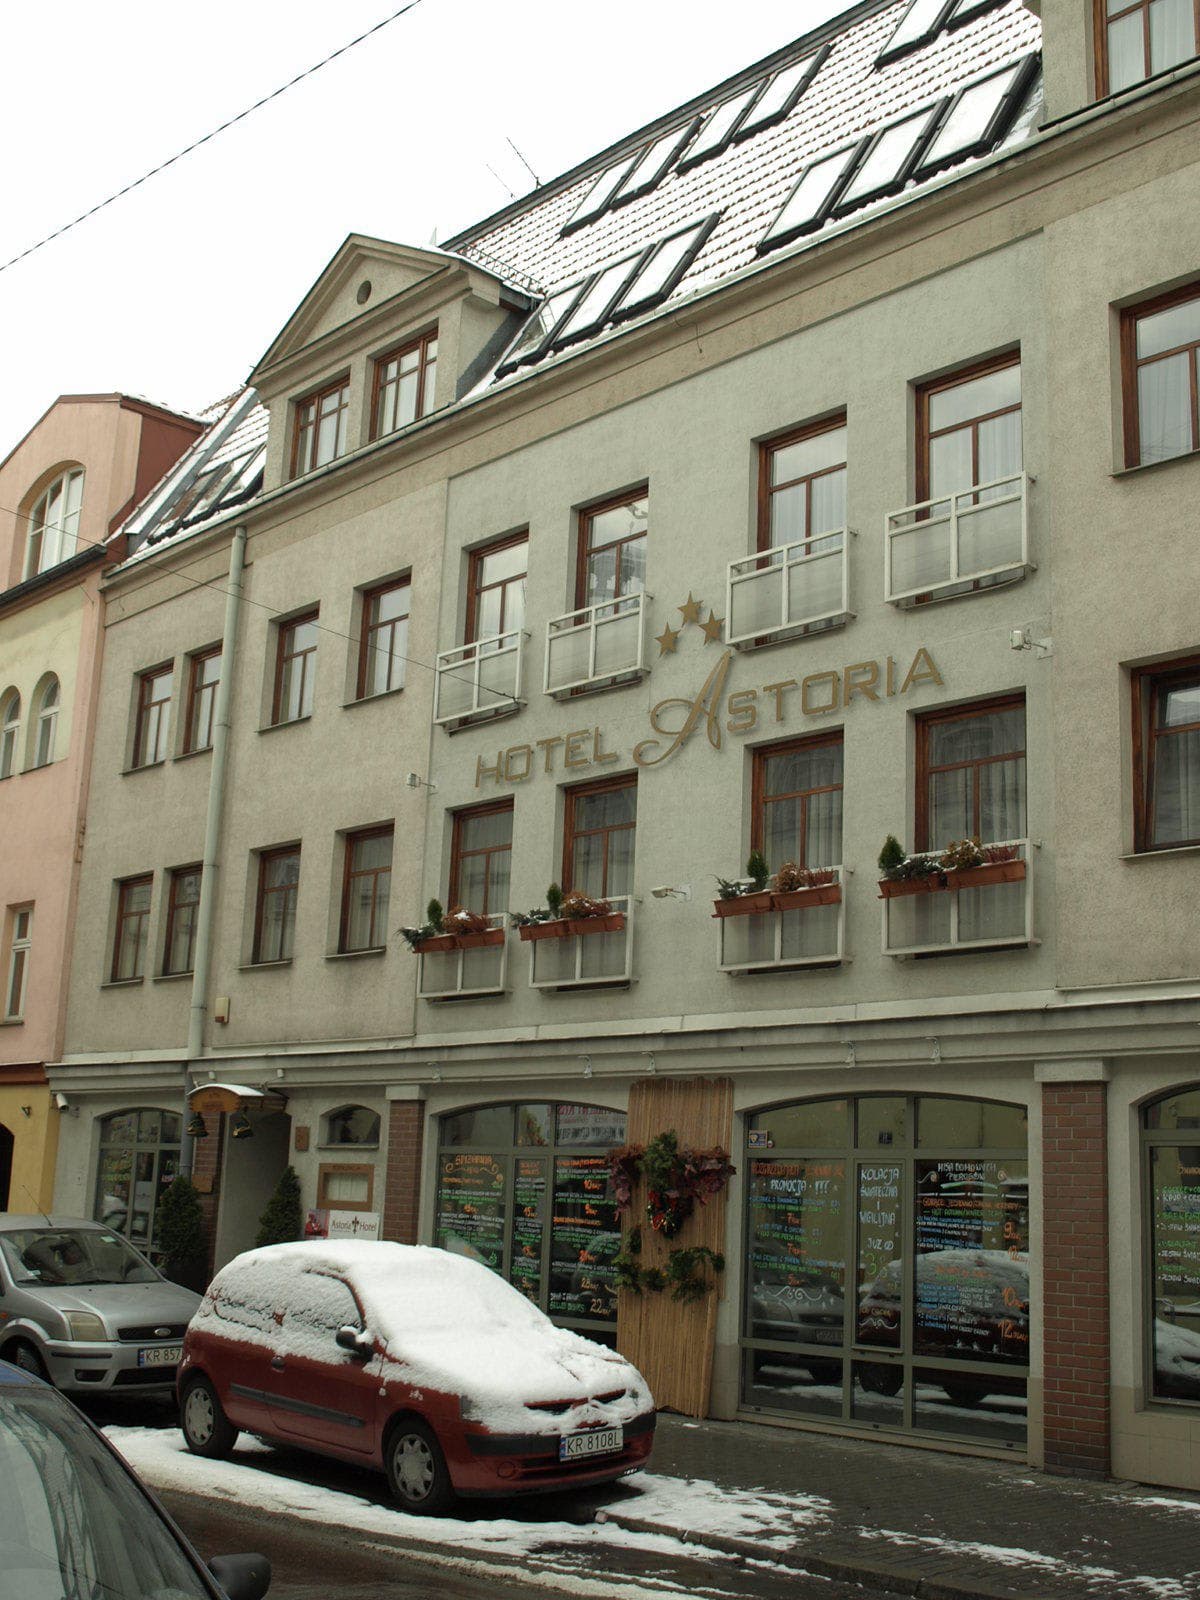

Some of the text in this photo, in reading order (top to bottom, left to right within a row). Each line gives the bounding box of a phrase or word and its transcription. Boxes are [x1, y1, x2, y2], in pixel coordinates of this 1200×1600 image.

[474, 647, 945, 789] HOTEL ASTORIA
[861, 1168, 900, 1185] KOLACJA
[145, 1350, 160, 1362] KR
[567, 1432, 620, 1454] KR 8108L
